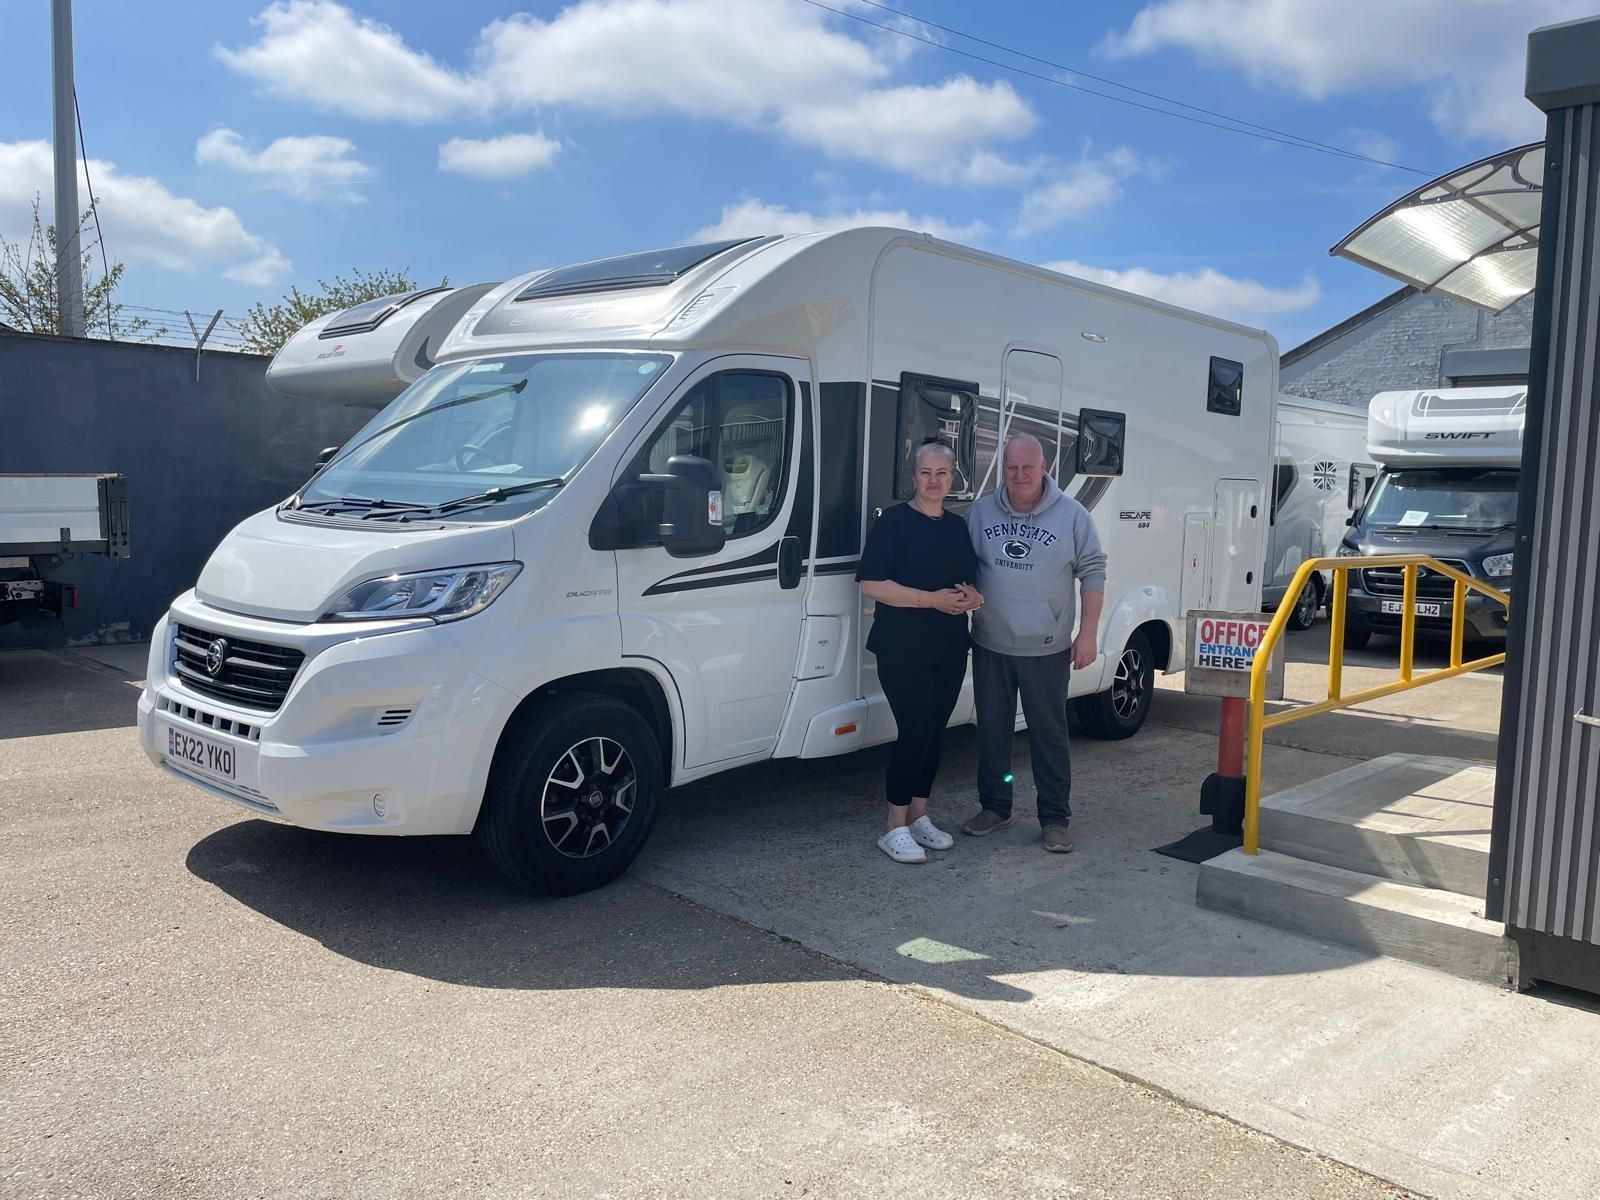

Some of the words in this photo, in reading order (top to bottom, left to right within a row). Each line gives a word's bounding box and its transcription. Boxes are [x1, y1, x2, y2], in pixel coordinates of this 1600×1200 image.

[1425, 432, 1496, 440] SWIFT
[1120, 511, 1151, 520] ESCAPE
[995, 558, 1034, 571] UNIVERSITY
[1417, 605, 1438, 615] LHZ
[1199, 655, 1244, 669] HERE
[175, 732, 204, 765] EX22
[207, 743, 231, 774] YKO
